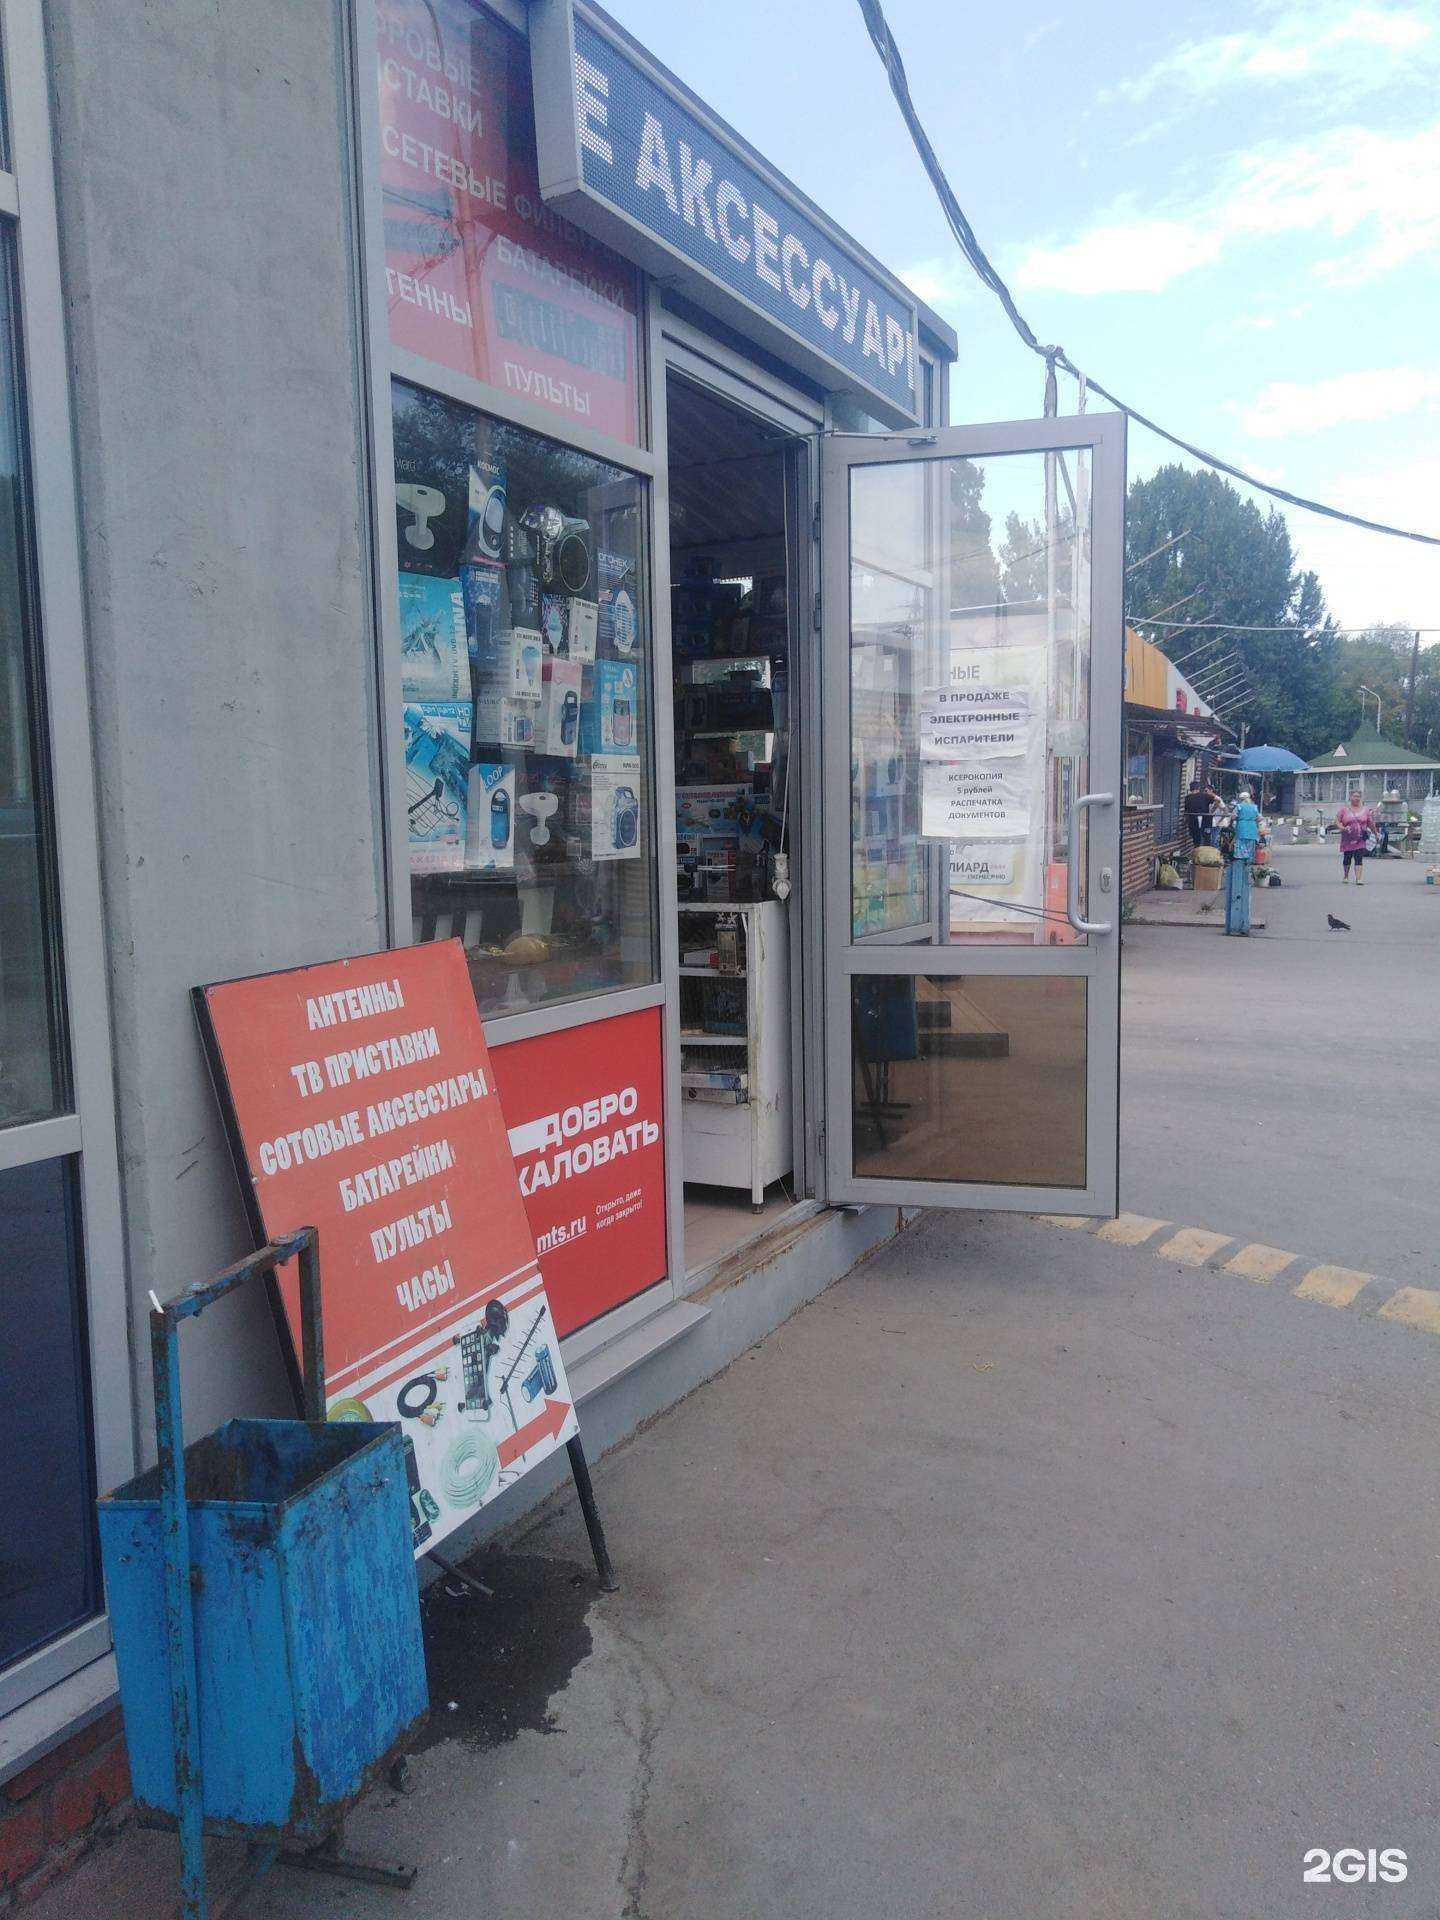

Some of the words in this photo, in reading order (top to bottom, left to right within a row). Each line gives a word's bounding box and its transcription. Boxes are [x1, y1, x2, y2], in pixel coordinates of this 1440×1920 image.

[382, 124, 508, 211] СЕТЕВЫЕ
[503, 360, 592, 417] ПУЛЬТЫ
[929, 712, 1020, 725] ЭЛЕКТРОННЫЕ
[939, 694, 947, 703] В
[950, 691, 1010, 702] ПРОДАЖЕ
[934, 733, 1015, 745] ИСПАРИТЕЛИ
[948, 772, 1003, 782] КСЕРОКОПИЯ
[950, 798, 1003, 808] РАСПЕЧАТКА
[957, 786, 962, 794] 5
[963, 785, 993, 796] рублей
[948, 811, 1006, 820] ДОКУМЕНТОВ
[306, 979, 405, 1031] АНТЕННЫ
[290, 1060, 324, 1098] ТВ
[324, 1027, 441, 1088] ПРИСТАВКИ
[259, 1110, 365, 1175] СОТОВЫЕ
[368, 1068, 489, 1137] АКСЕССУАРЫ
[538, 1086, 638, 1153] ДОБРО
[338, 1139, 454, 1212] БАТАРЕЙКИ
[369, 1199, 453, 1263] ПУЛЬТЫ
[536, 1215, 588, 1254] mts.ru
[395, 1259, 456, 1313] ЧАСЫ
